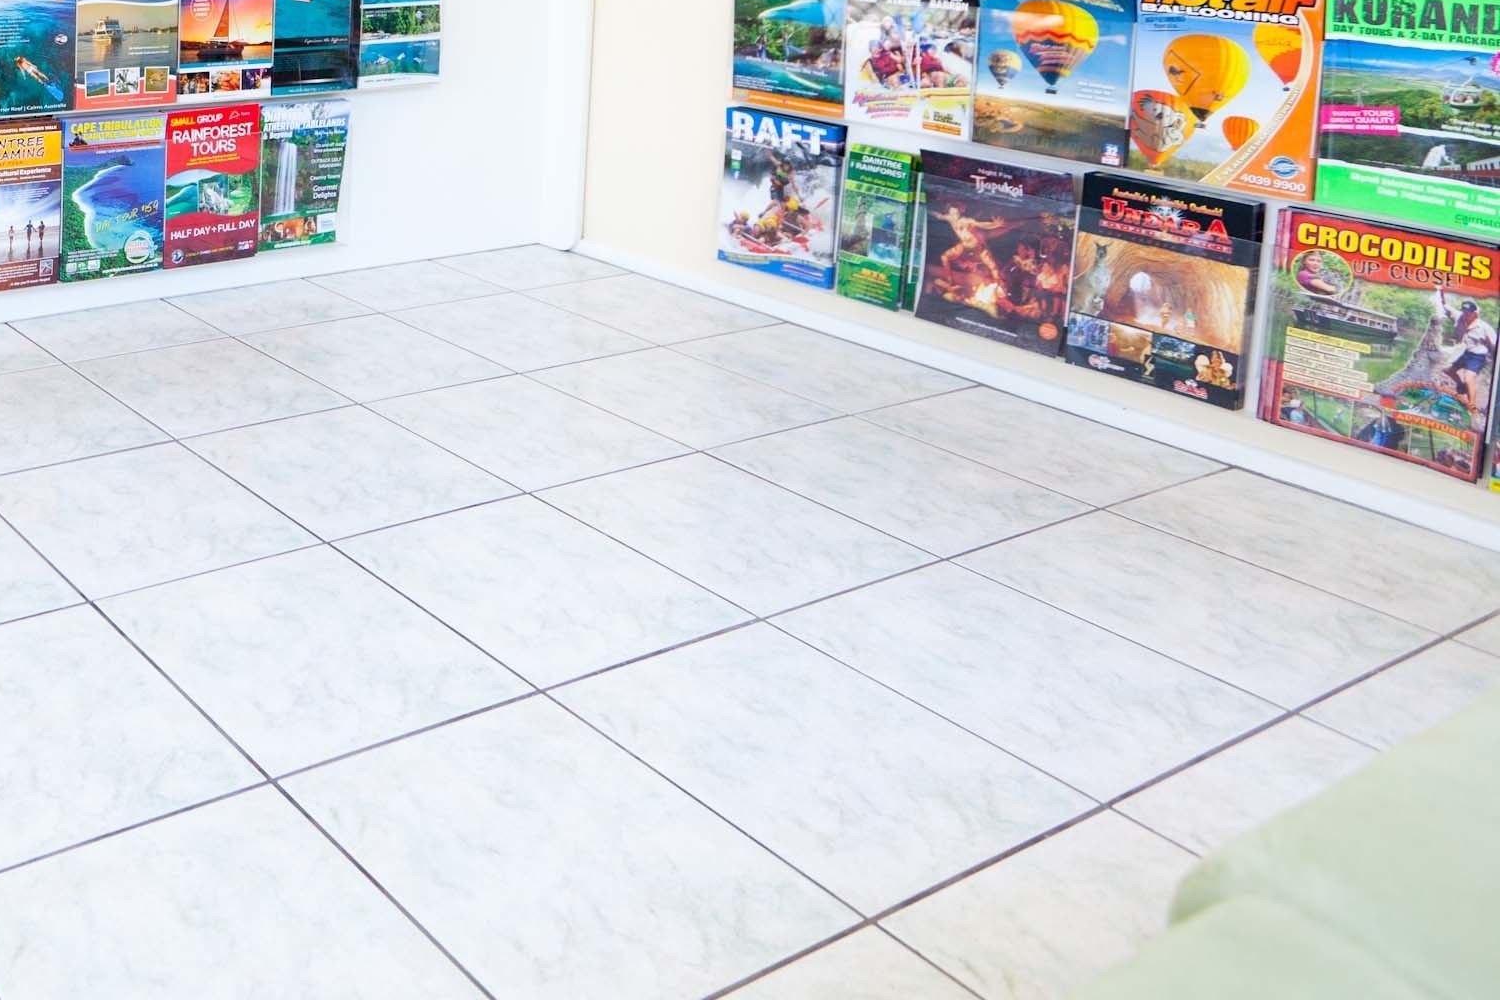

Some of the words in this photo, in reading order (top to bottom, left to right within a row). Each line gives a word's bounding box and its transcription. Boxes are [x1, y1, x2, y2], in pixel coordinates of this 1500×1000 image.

[1140, 2, 1300, 26] BALLOONING
[1333, 24, 1354, 33] DAY
[1359, 26, 1393, 37] TOURS
[1410, 31, 1444, 41] 2-DAY
[171, 117, 195, 127] SMALL
[197, 114, 223, 124] GROUP
[301, 117, 346, 129] TABLELANDS
[172, 122, 253, 144] RAINFOREST
[731, 111, 827, 155] RAFT
[191, 140, 237, 157] TOURS
[20, 167, 52, 177] Experience
[313, 191, 337, 200] Delights
[170, 228, 192, 241] HALF
[193, 226, 210, 238] DAY
[217, 222, 236, 234] FULL
[238, 220, 255, 230] DAY
[1297, 222, 1492, 280] CROCODILES
